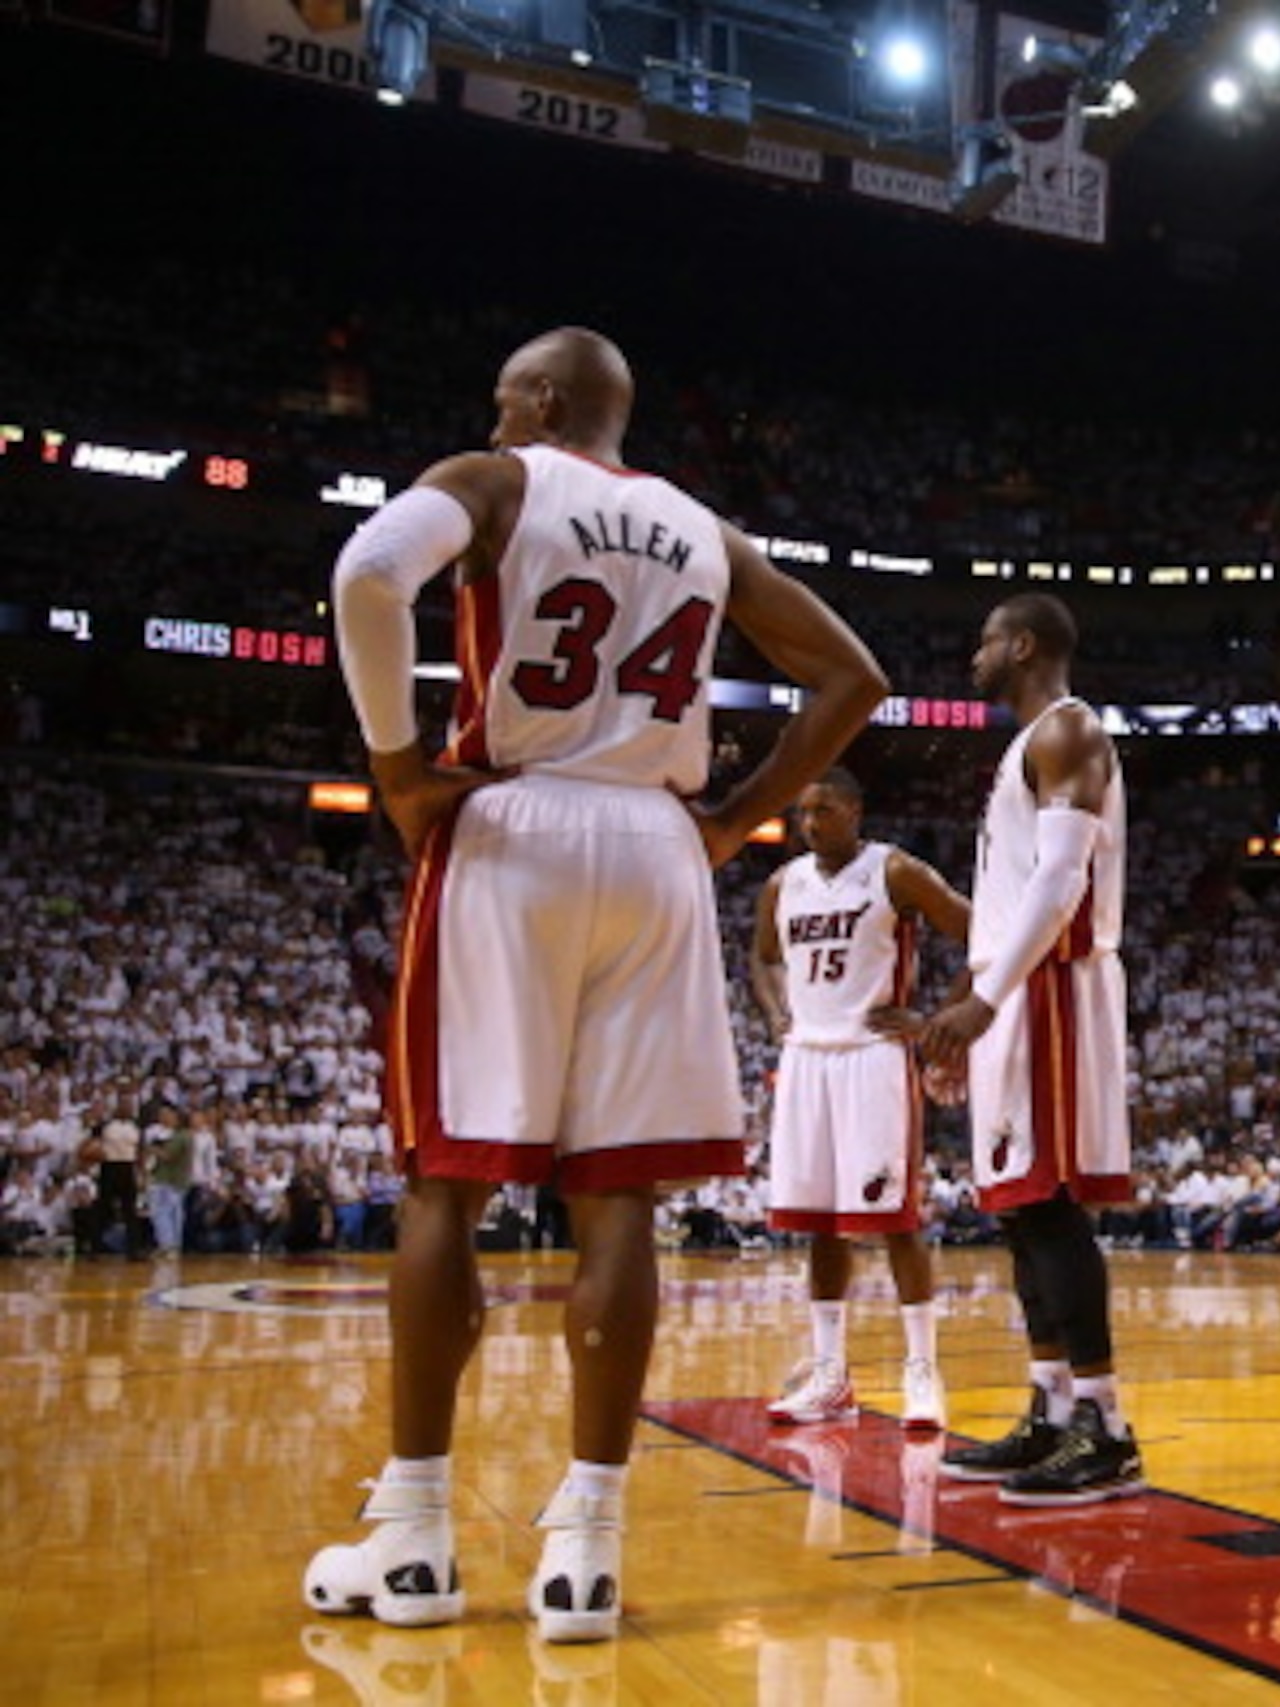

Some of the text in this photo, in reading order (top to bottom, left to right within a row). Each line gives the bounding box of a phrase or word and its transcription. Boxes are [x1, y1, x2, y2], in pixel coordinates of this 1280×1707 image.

[517, 88, 620, 139] 2012
[204, 454, 248, 490] 88
[568, 508, 693, 574] ALLEN
[144, 617, 231, 658] CHRIS
[233, 626, 326, 667] BOSH
[509, 573, 715, 725] 34
[911, 700, 986, 728] BOSH
[788, 899, 873, 946] HEAT
[808, 947, 850, 983] 15
